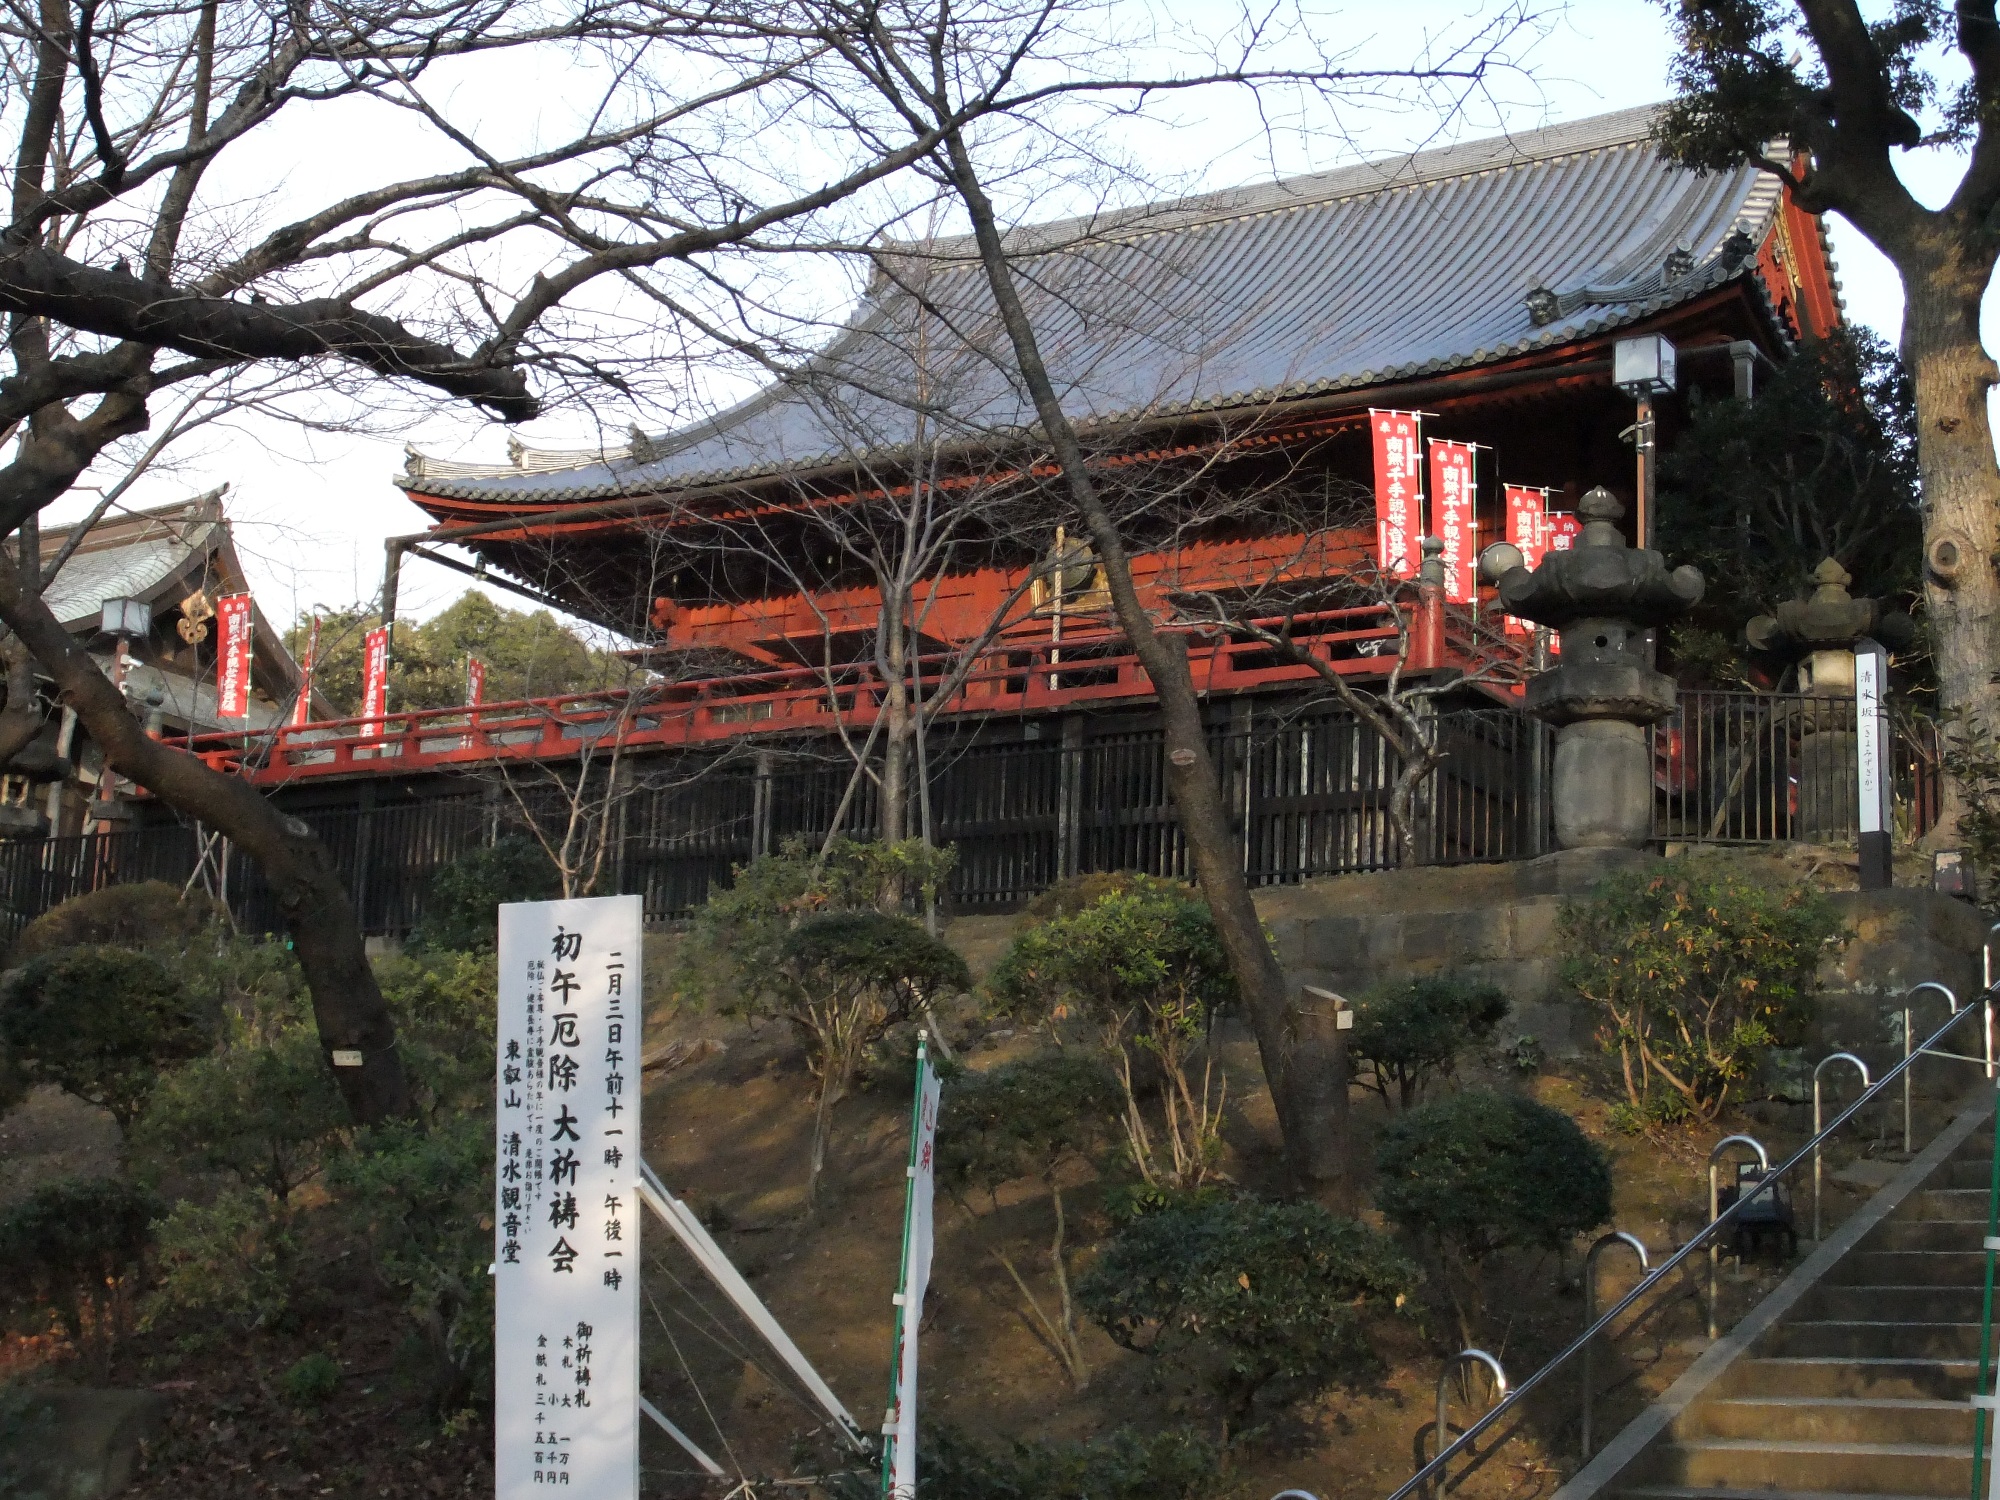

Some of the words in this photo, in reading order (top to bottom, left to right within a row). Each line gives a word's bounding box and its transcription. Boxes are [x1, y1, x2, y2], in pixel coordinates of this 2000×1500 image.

[503, 1039, 522, 1109] 東叡山
[604, 952, 625, 1291] 二月三日午前十一時・午後一時
[501, 1131, 522, 1264] 清水観音堂
